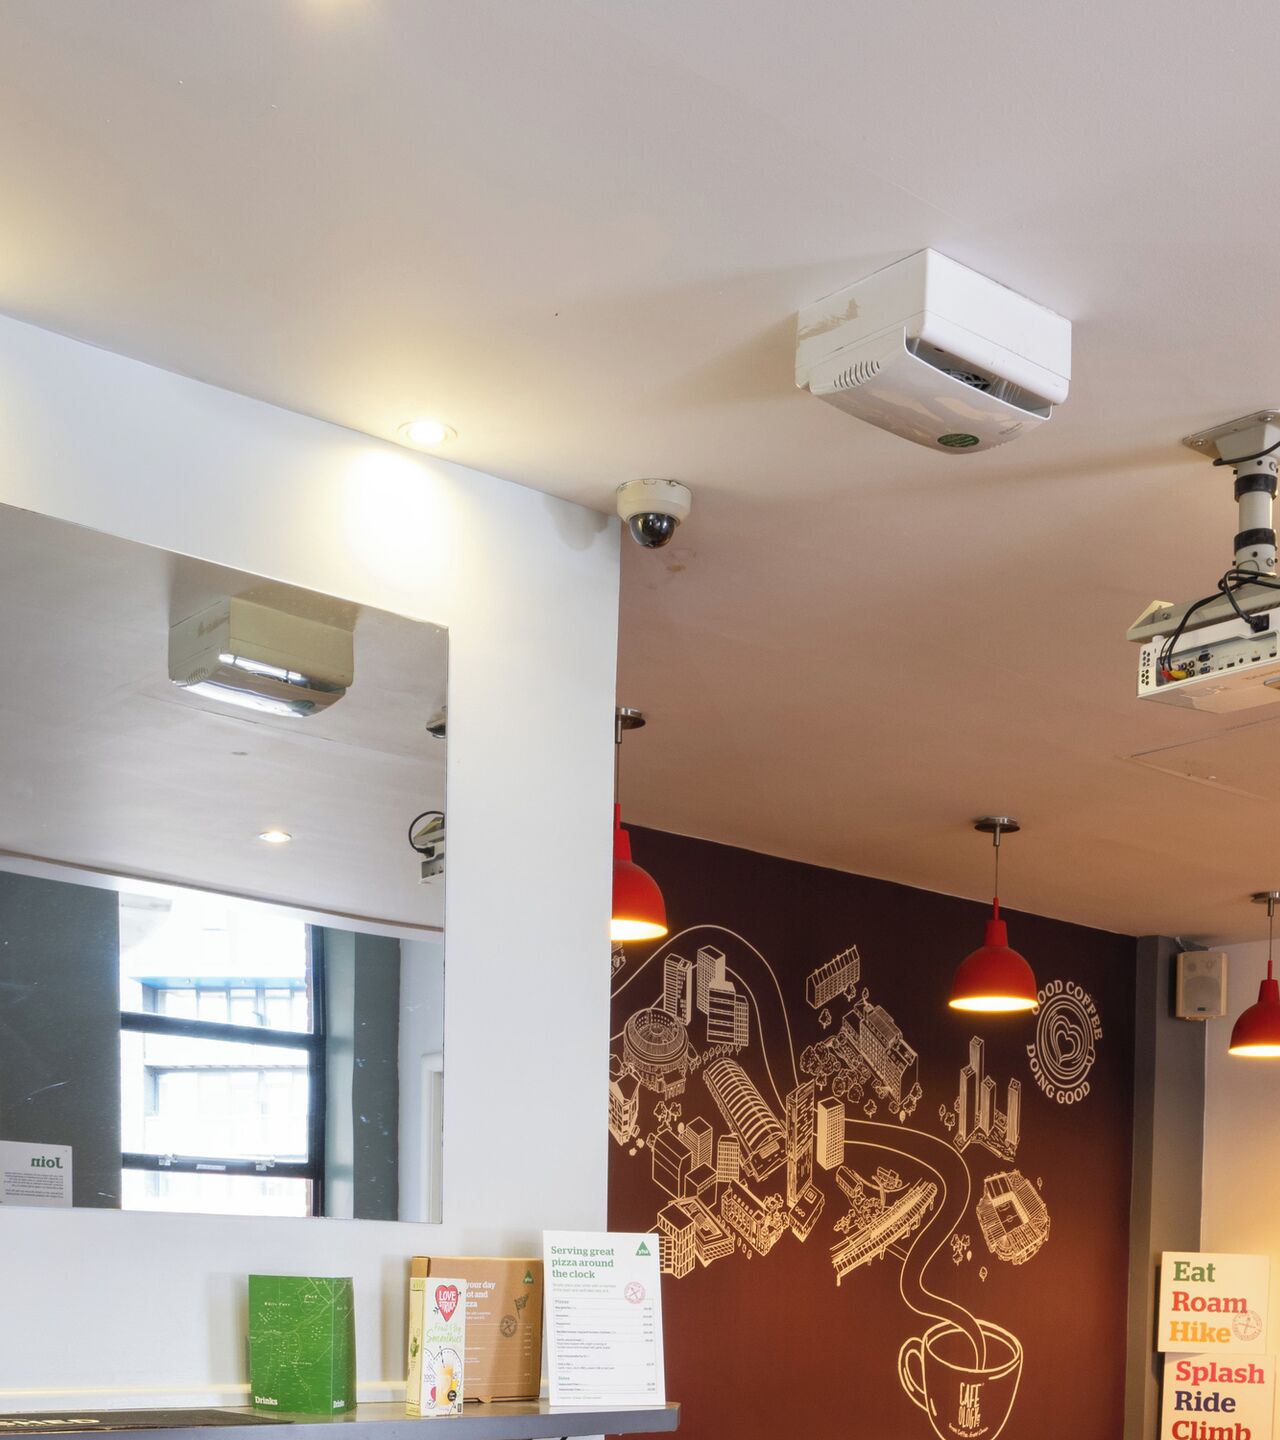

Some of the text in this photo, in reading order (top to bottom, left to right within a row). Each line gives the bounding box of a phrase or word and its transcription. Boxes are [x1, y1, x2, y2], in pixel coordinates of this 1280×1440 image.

[1066, 981, 1103, 1040] COFFEE
[1026, 1043, 1090, 1104] DOING GOOD
[551, 1246, 615, 1257] Serving great
[552, 1258, 614, 1268] pizza around
[552, 1269, 595, 1279] the clock
[1173, 1261, 1216, 1283] Eat
[439, 1291, 456, 1301] LOVE
[482, 1281, 496, 1290] day
[1171, 1291, 1248, 1314] Roam
[1169, 1321, 1231, 1343] Hike
[1175, 1361, 1265, 1386] Splash
[255, 1396, 278, 1406] Drinks
[960, 1382, 981, 1406] CAFE
[1174, 1391, 1236, 1413] Ride
